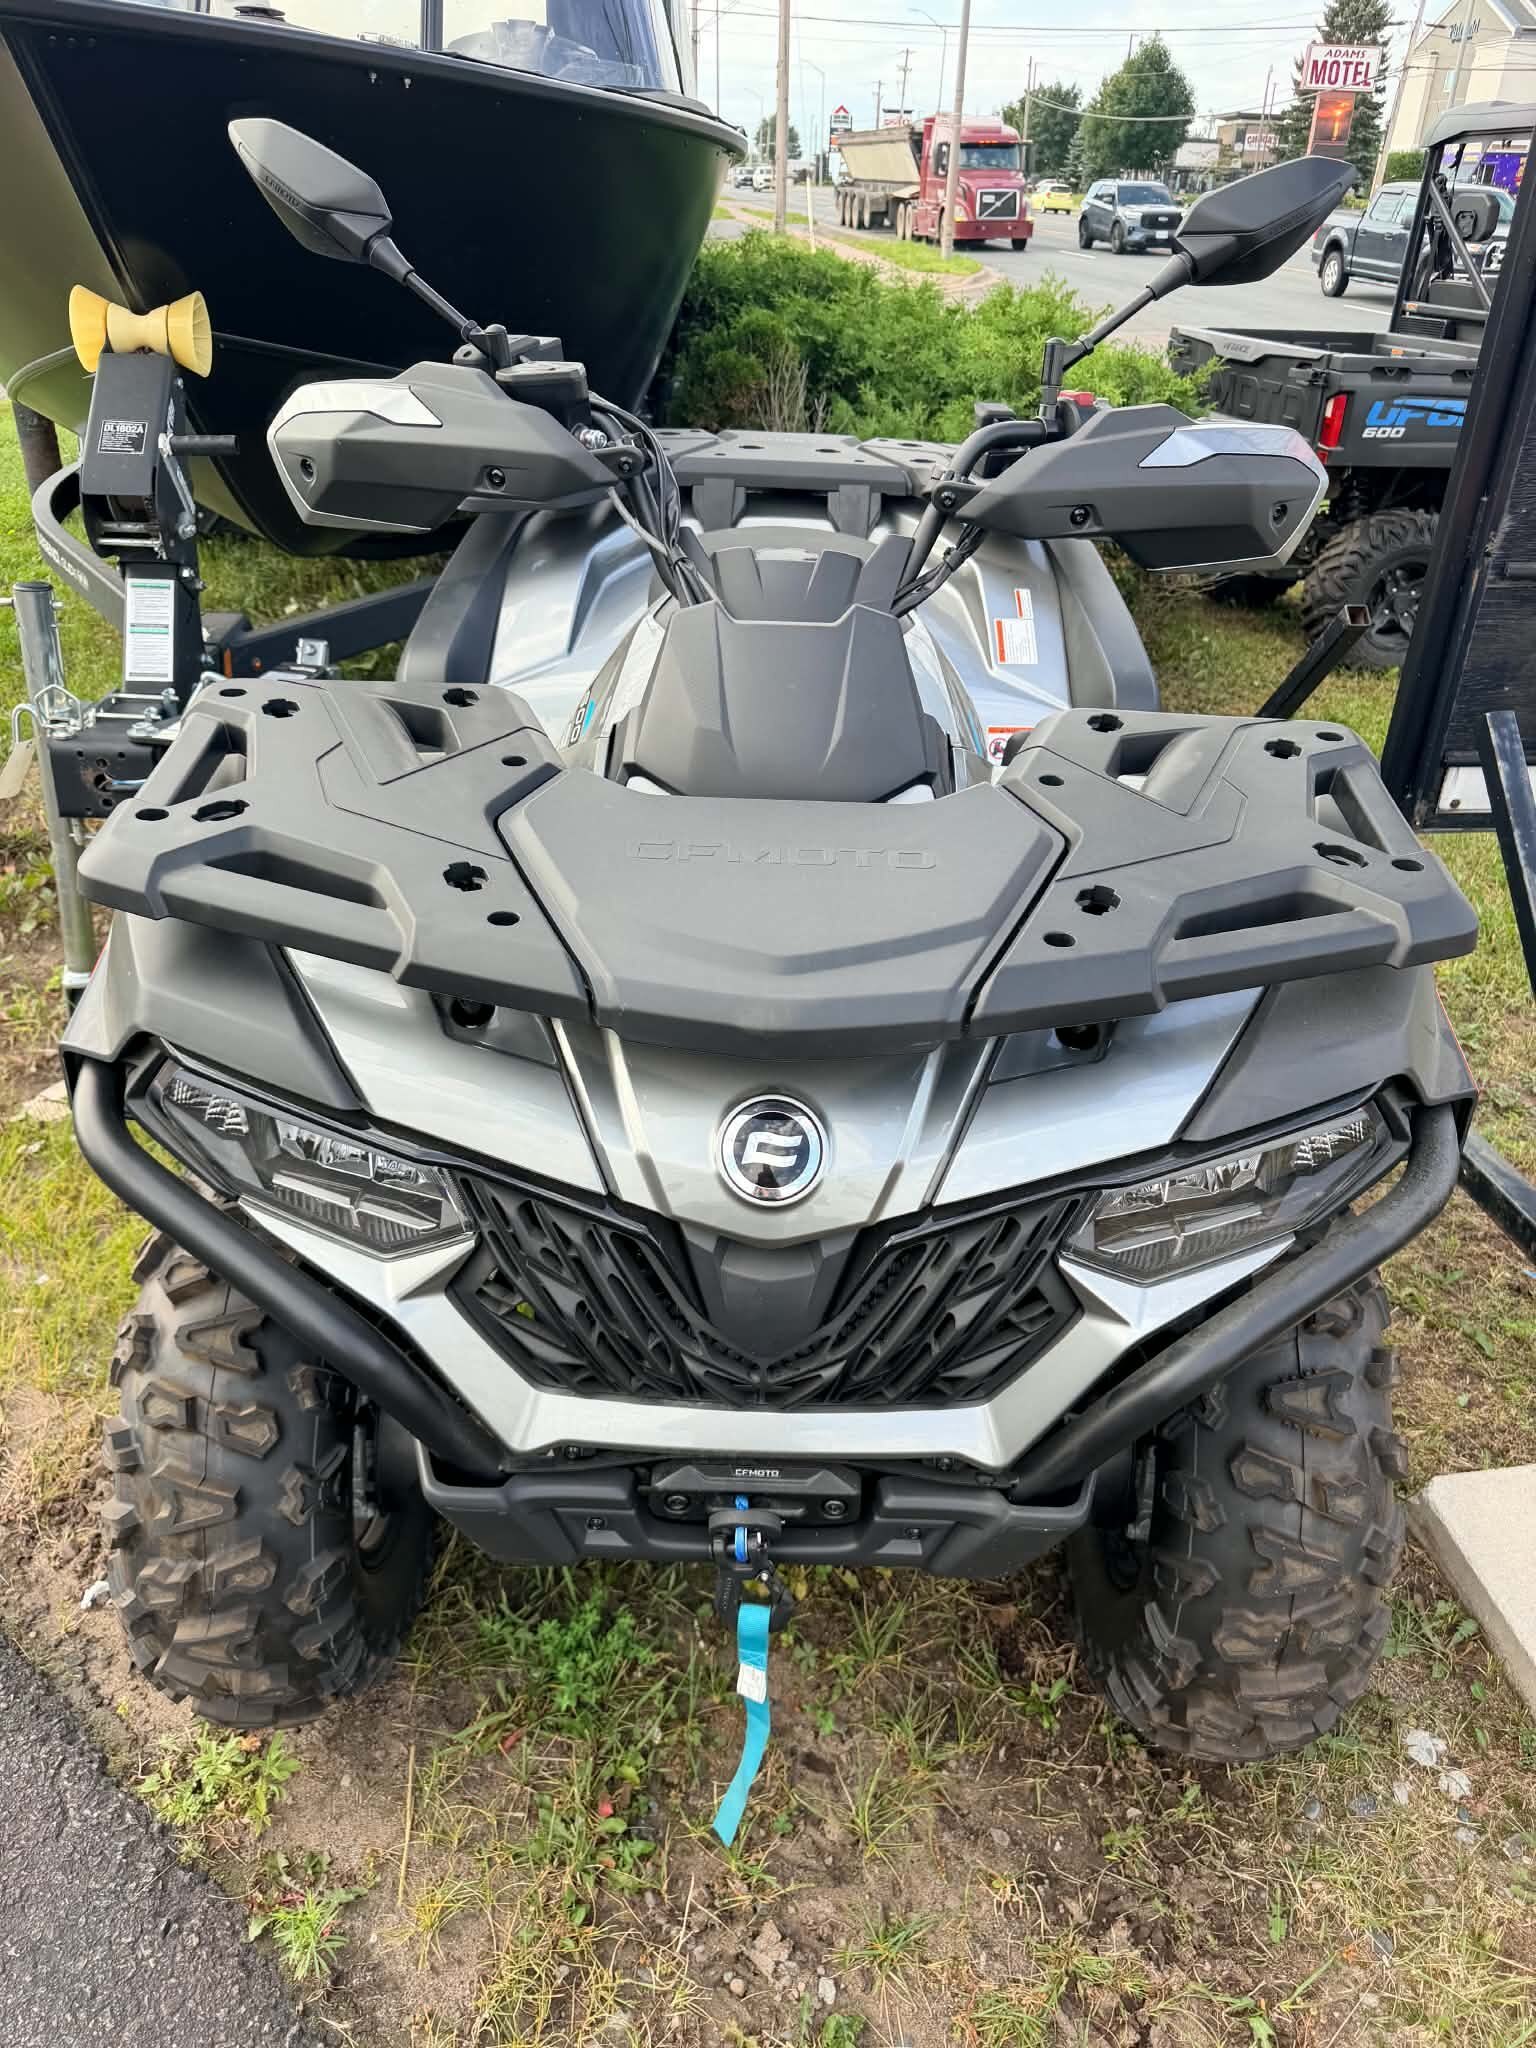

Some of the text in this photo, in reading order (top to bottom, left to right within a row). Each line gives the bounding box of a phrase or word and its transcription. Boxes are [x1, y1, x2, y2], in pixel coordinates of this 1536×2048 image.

[1324, 49, 1367, 59] ADAMS
[1310, 59, 1372, 87] MOTEL
[1366, 400, 1465, 427] UFO
[1361, 427, 1406, 438] 600
[630, 841, 937, 870] CFMOTO
[735, 1468, 780, 1478] CFMOTO
